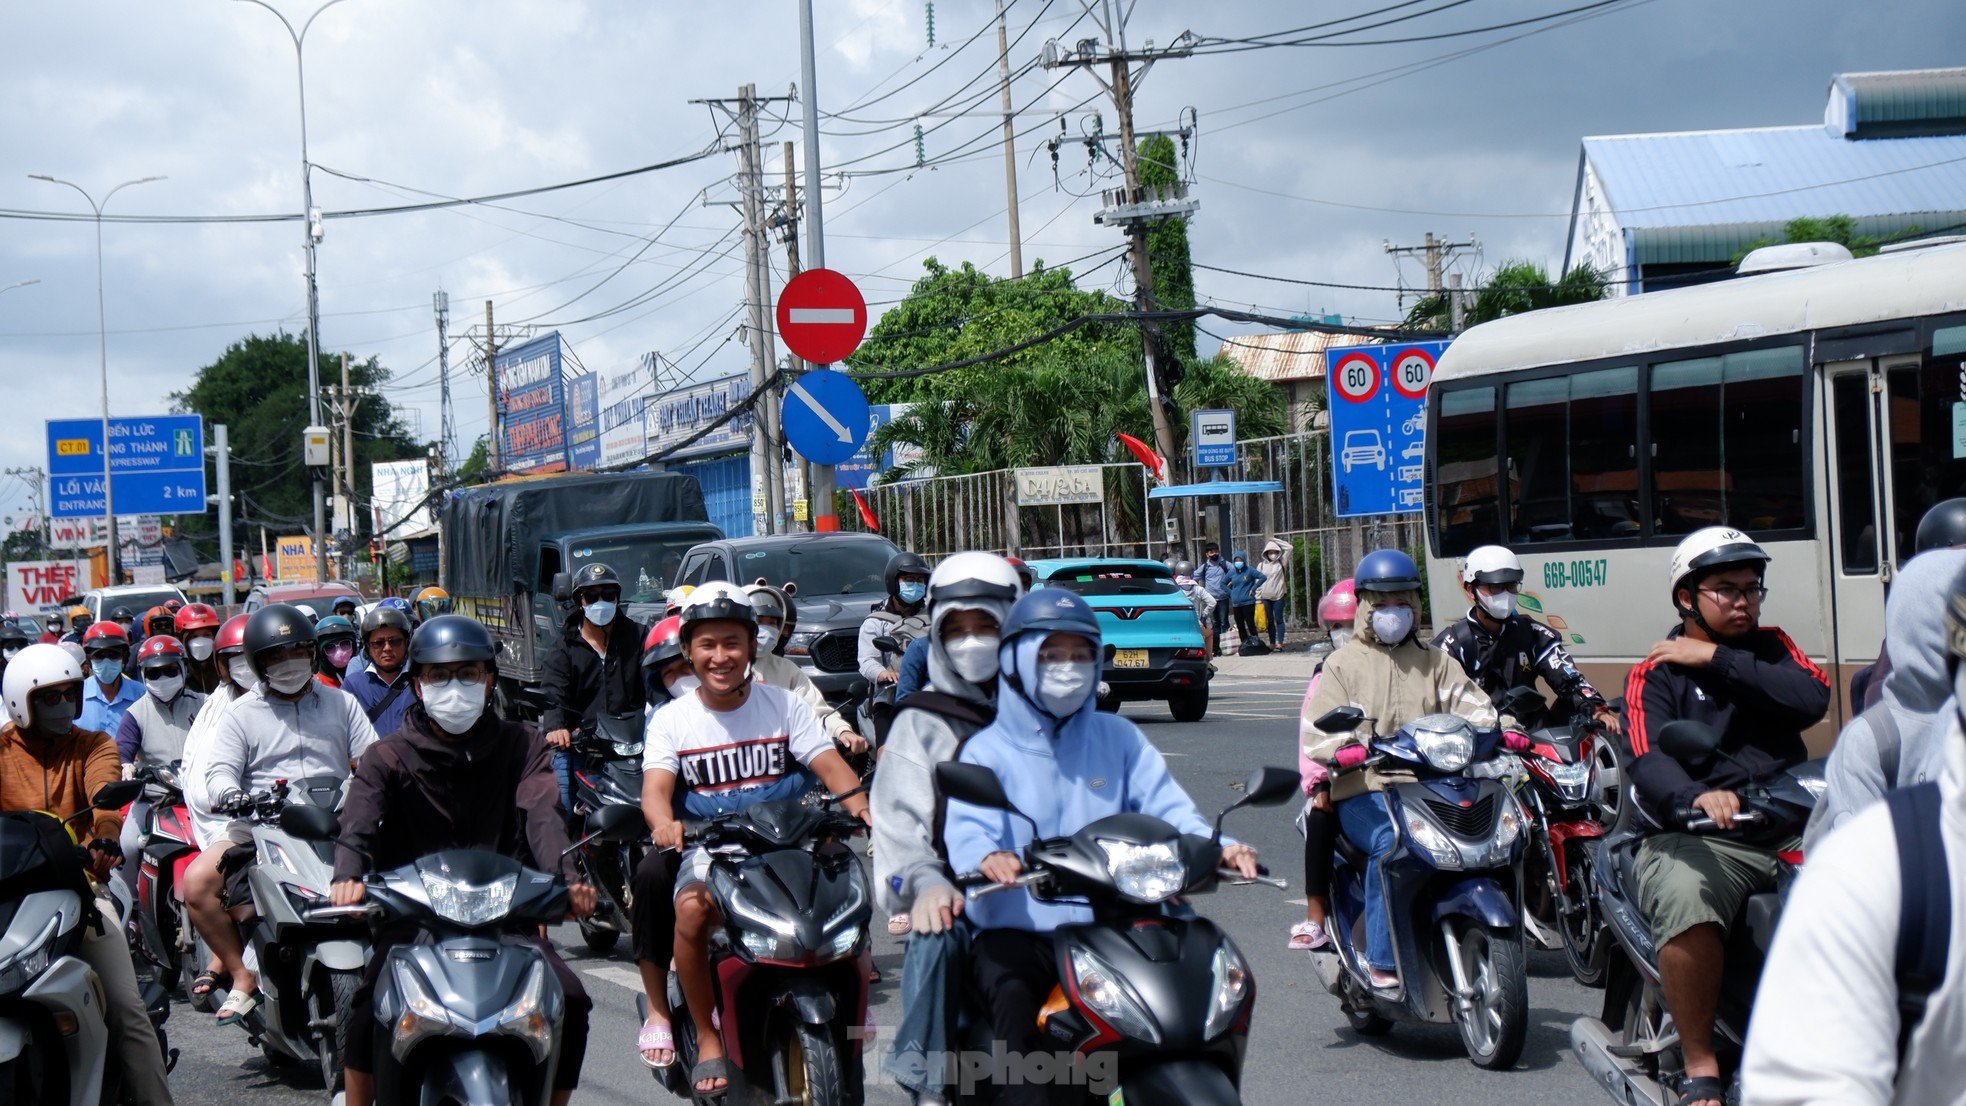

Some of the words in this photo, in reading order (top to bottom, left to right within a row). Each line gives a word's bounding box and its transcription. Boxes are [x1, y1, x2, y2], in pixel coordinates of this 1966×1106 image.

[1347, 367, 1366, 388] 60
[1405, 363, 1424, 383] 60
[96, 442, 126, 454] LNG
[110, 458, 160, 467] XPRESSWAY
[59, 478, 80, 495] LỐI
[163, 486, 171, 498] 2
[177, 486, 196, 498] km
[59, 501, 106, 511] ENTRANC
[1544, 559, 1607, 588] 66B-00547
[1122, 651, 1139, 659] 62H
[681, 742, 780, 786] ATTITUDE
